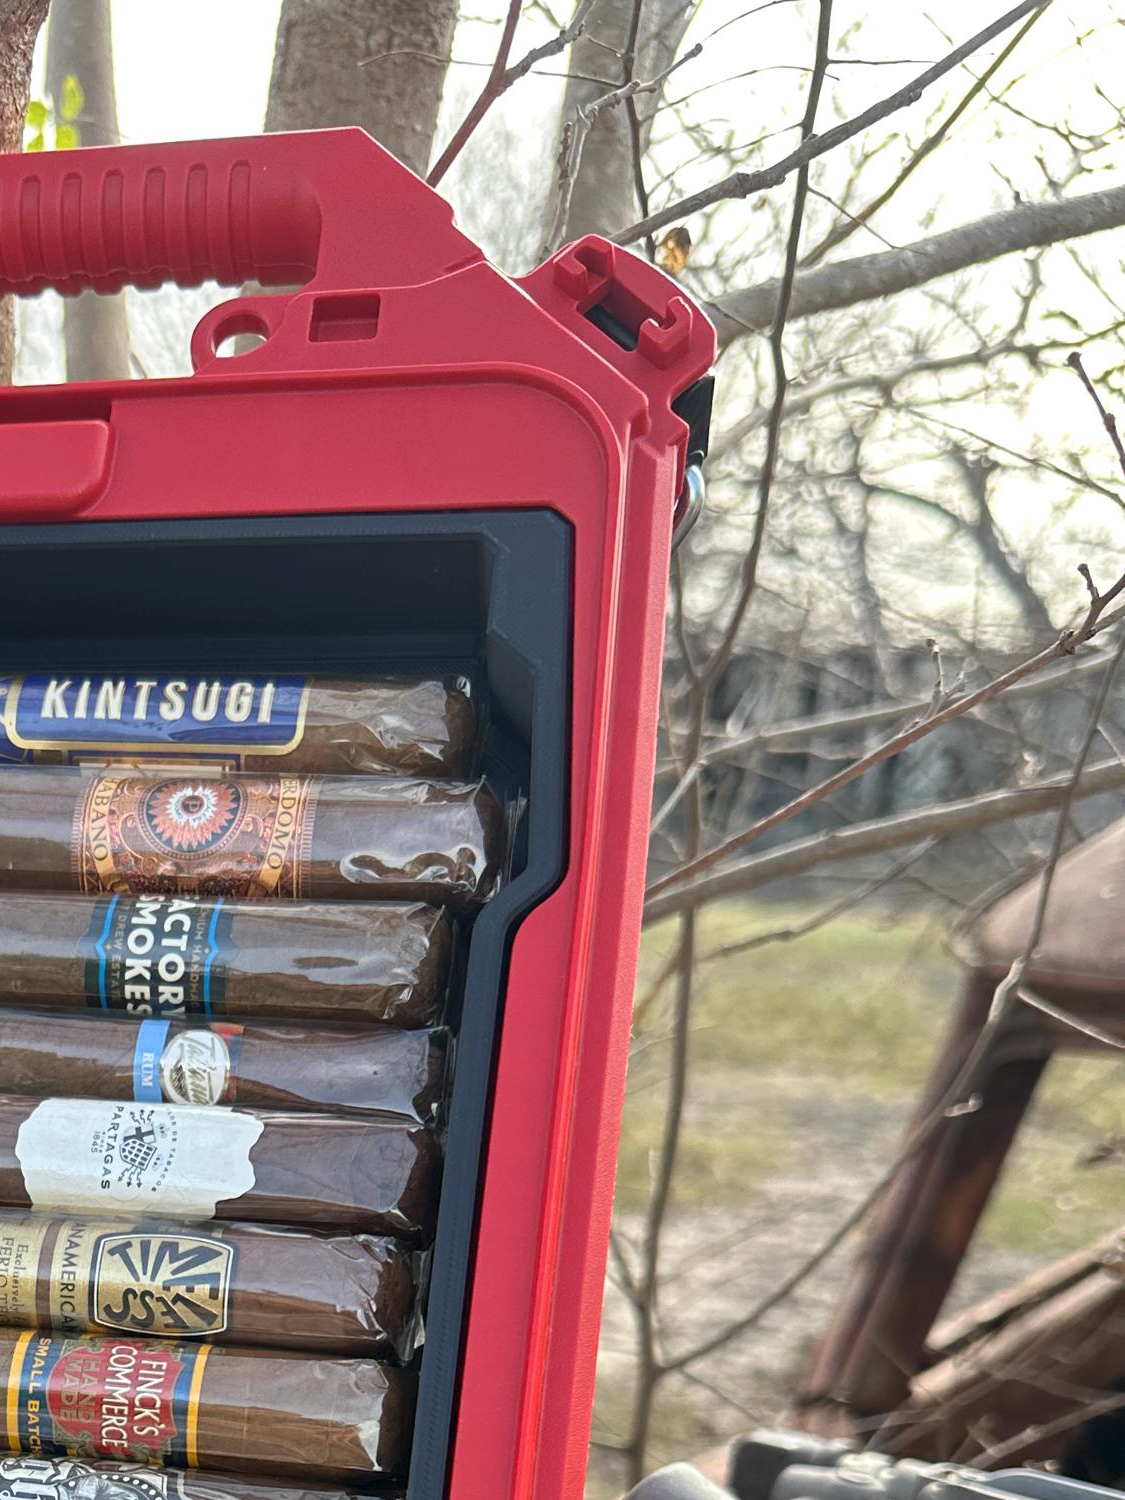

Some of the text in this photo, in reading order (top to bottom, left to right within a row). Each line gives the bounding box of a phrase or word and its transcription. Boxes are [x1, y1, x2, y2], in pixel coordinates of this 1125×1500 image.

[40, 679, 274, 724] KINTSUGI
[267, 778, 299, 869] ERDOMO
[124, 895, 165, 1016] SMOKES
[161, 897, 196, 1018] ACTORY
[141, 1052, 155, 1088] RUM
[101, 1106, 125, 1189] PARTAGAS
[9, 1244, 29, 1311] Exclusively
[28, 1338, 52, 1394] SMALL
[59, 1358, 84, 1421] MADE
[77, 1359, 102, 1424] HAND
[101, 1345, 138, 1448] COMMERCE
[132, 1359, 168, 1437] FINCK'S
